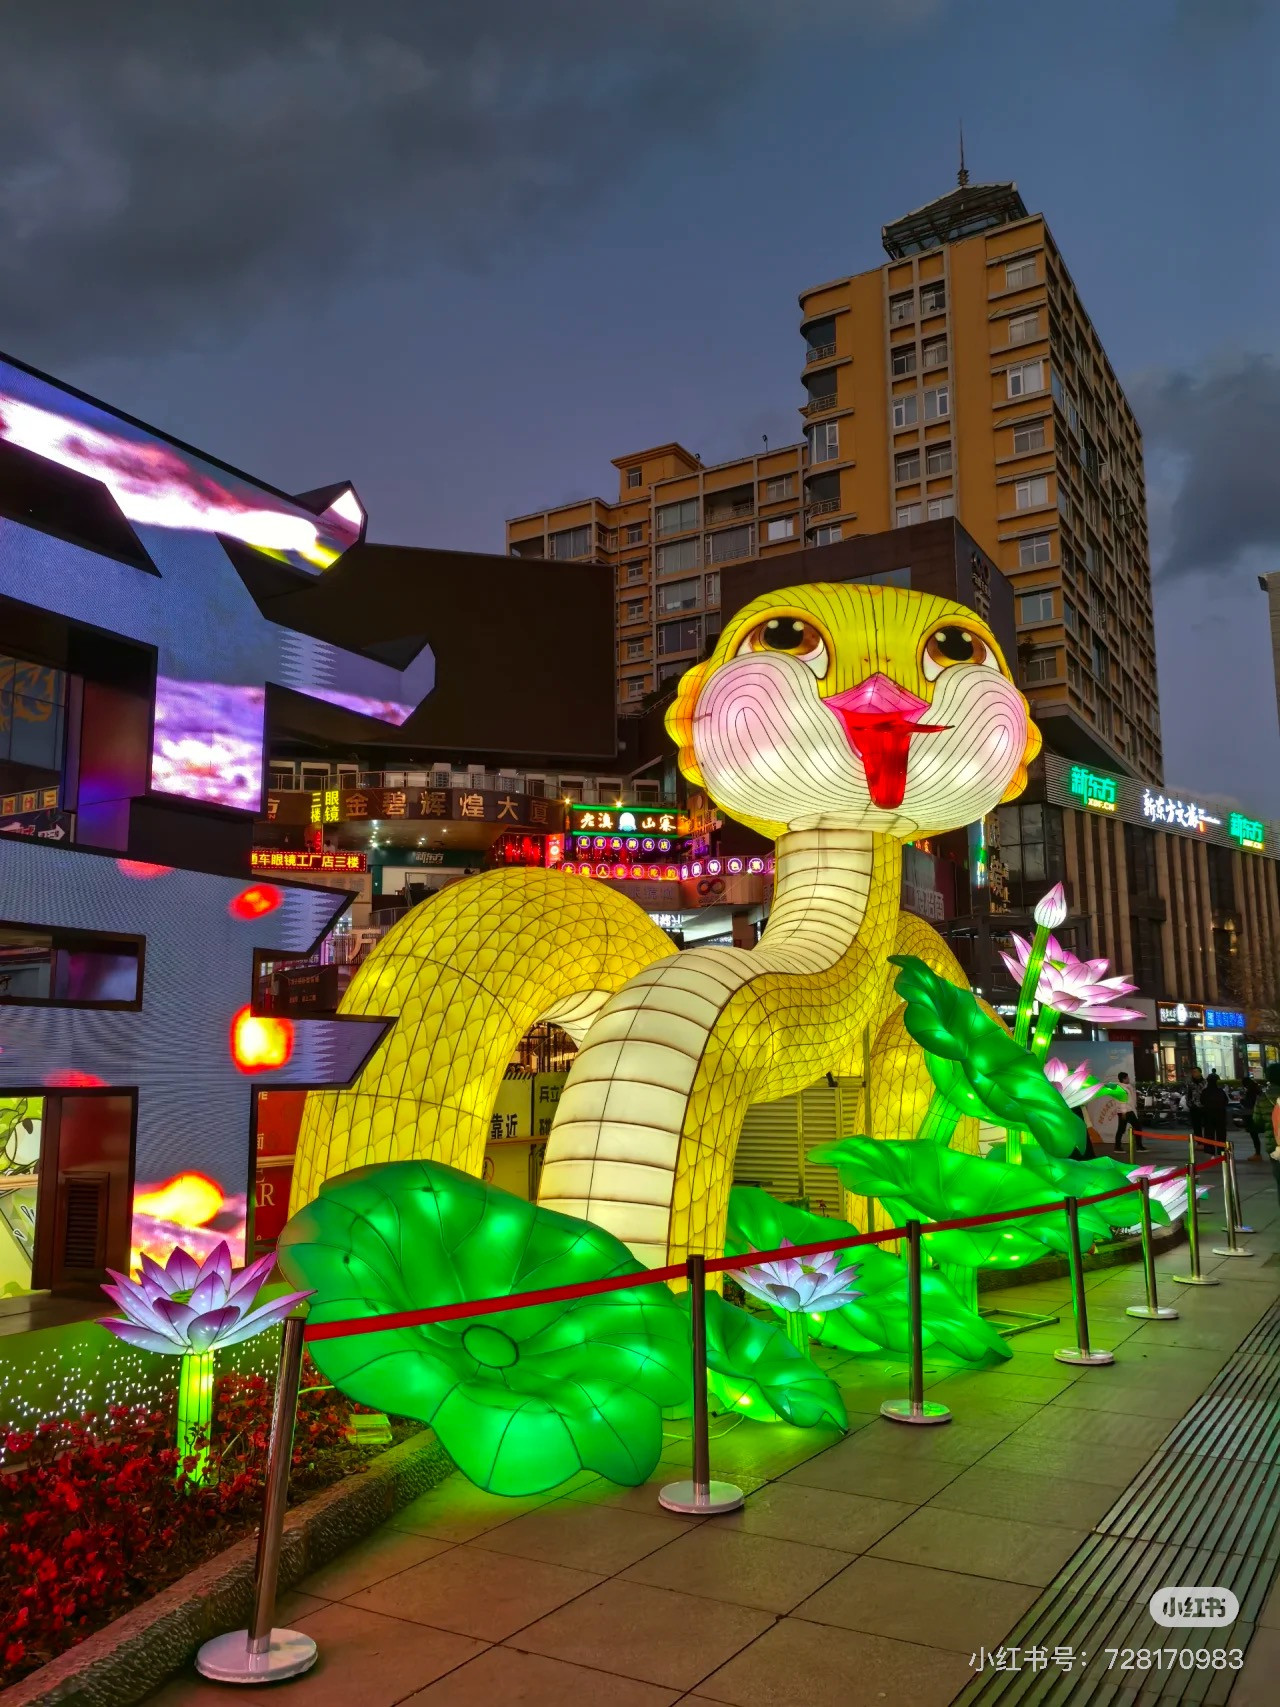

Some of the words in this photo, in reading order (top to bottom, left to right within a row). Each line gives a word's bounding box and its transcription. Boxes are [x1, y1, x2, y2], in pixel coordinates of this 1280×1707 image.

[1071, 766, 1116, 805] 新东方
[311, 792, 322, 823] 三楼
[324, 790, 340, 822] 眼镜
[346, 791, 549, 824] 金碧辉煌大厦
[1142, 788, 1200, 828] 新东方文旅
[1230, 812, 1263, 844] 新东方
[490, 1113, 518, 1139] 靠近
